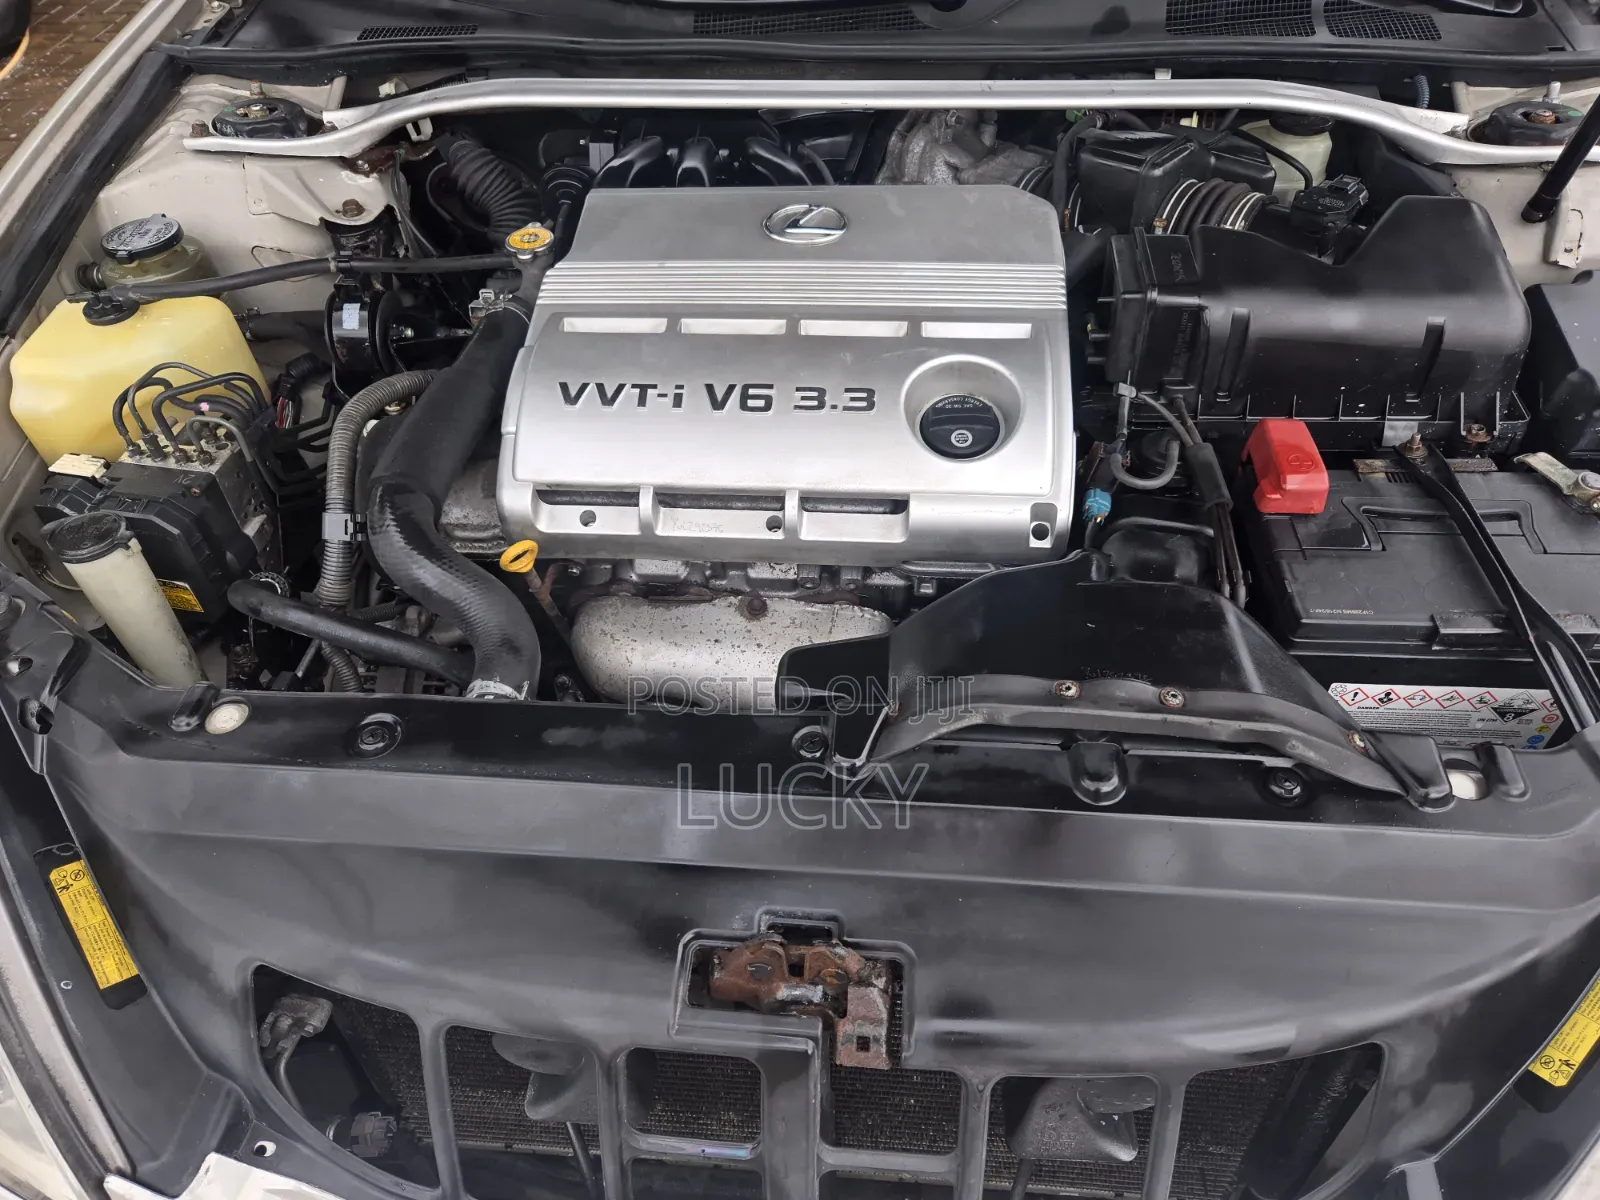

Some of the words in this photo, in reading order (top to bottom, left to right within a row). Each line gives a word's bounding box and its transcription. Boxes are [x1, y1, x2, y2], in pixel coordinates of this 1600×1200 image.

[558, 382, 685, 410] VVT-i
[704, 383, 775, 415] V6
[793, 386, 877, 415] 3.3
[1504, 713, 1515, 721] 8
